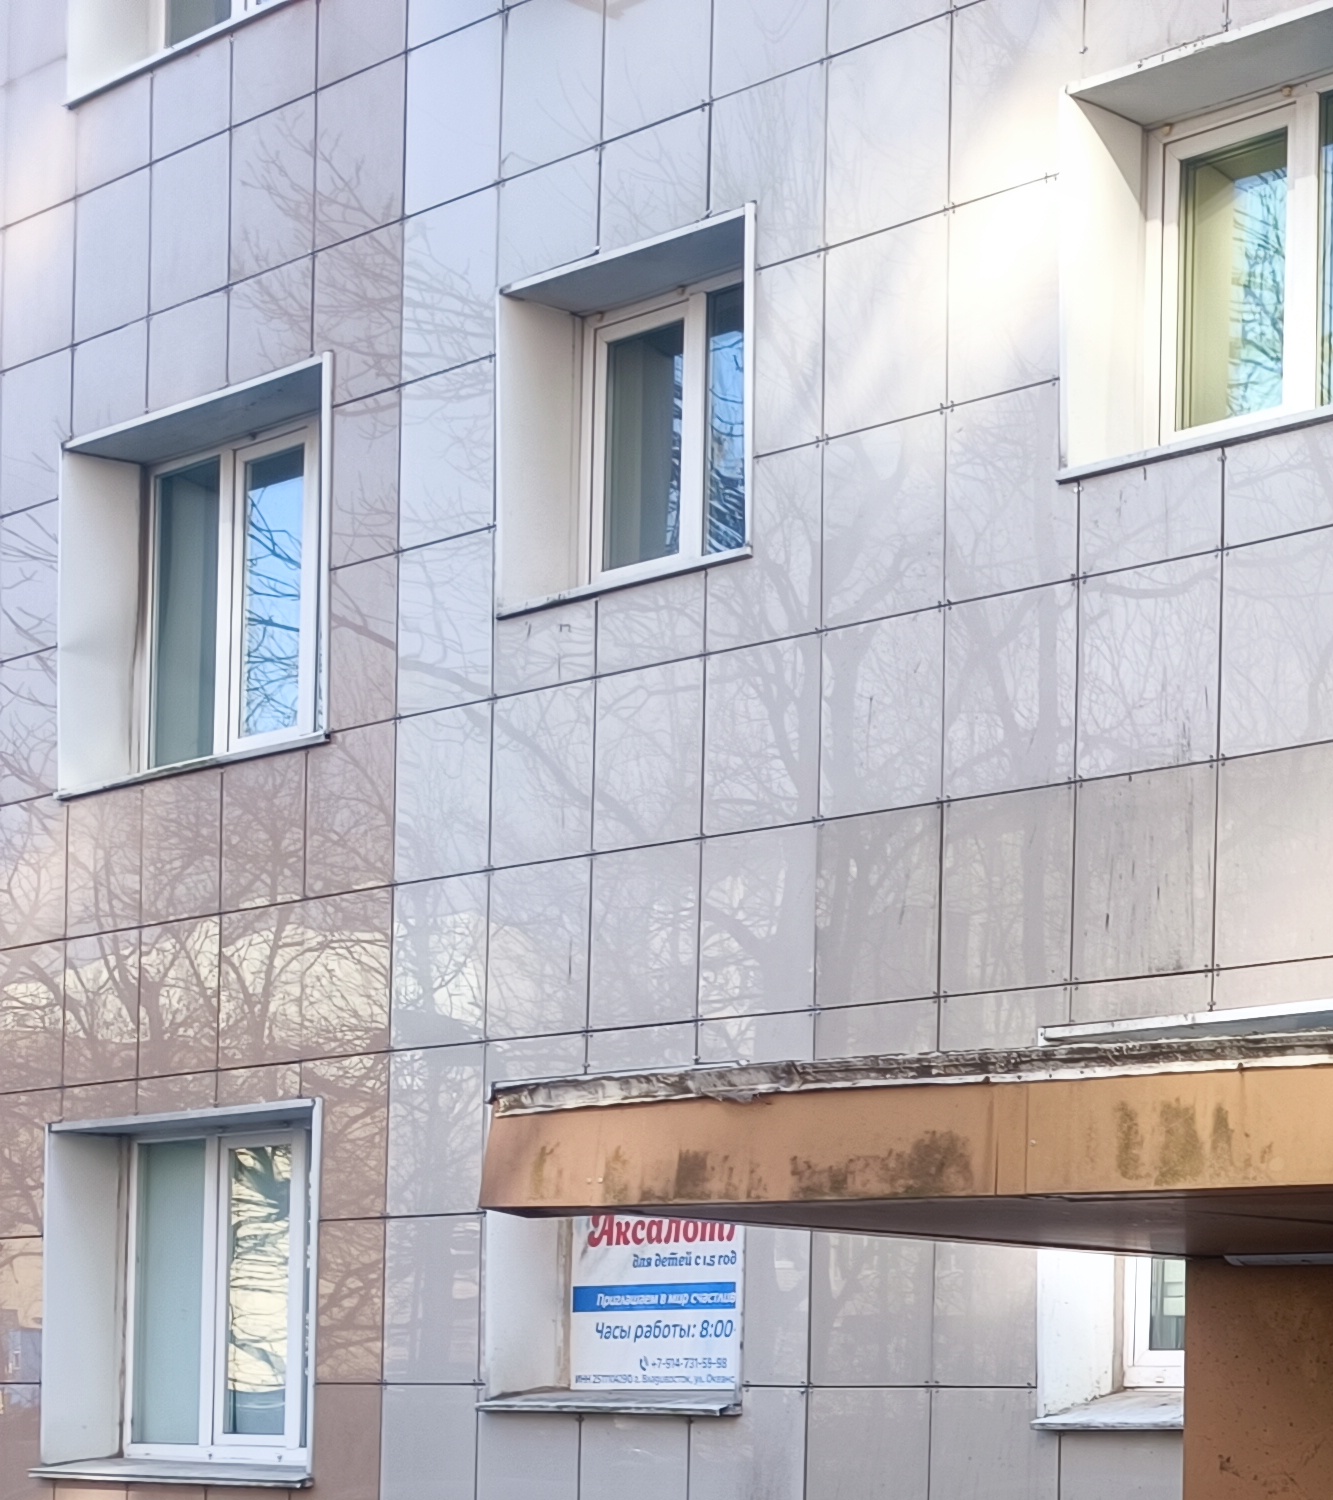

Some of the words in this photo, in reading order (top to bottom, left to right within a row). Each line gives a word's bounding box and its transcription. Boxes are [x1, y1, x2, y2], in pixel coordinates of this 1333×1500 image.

[632, 1253, 652, 1268] для
[655, 1251, 692, 1267] детей
[595, 1322, 631, 1340] Часы
[633, 1319, 697, 1342] работы:
